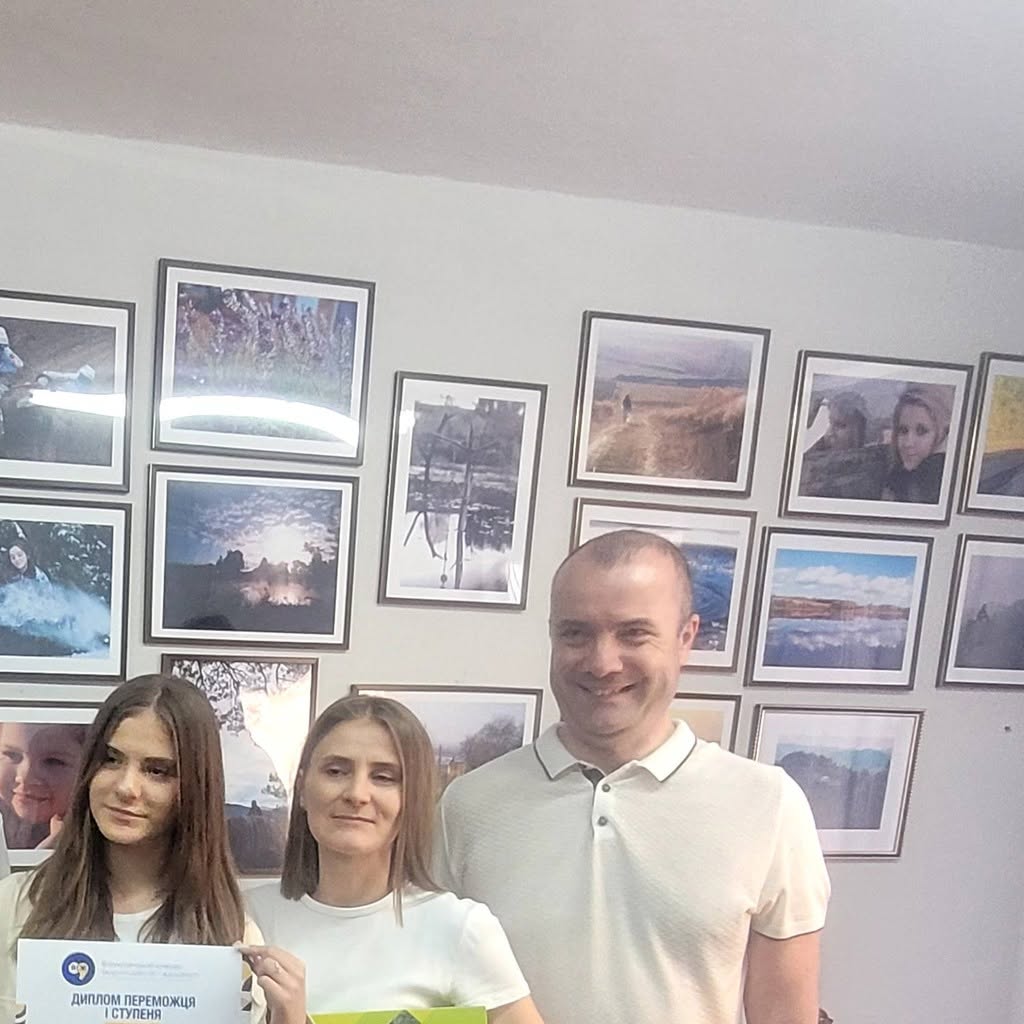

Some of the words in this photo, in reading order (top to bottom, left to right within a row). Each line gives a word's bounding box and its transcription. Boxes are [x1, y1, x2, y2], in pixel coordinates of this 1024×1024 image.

[71, 993, 120, 1007] ДИПЛОМ
[125, 995, 196, 1009] ПЕРЕМОЖЦЯ
[111, 1007, 162, 1020] СТУПЕНЯ
